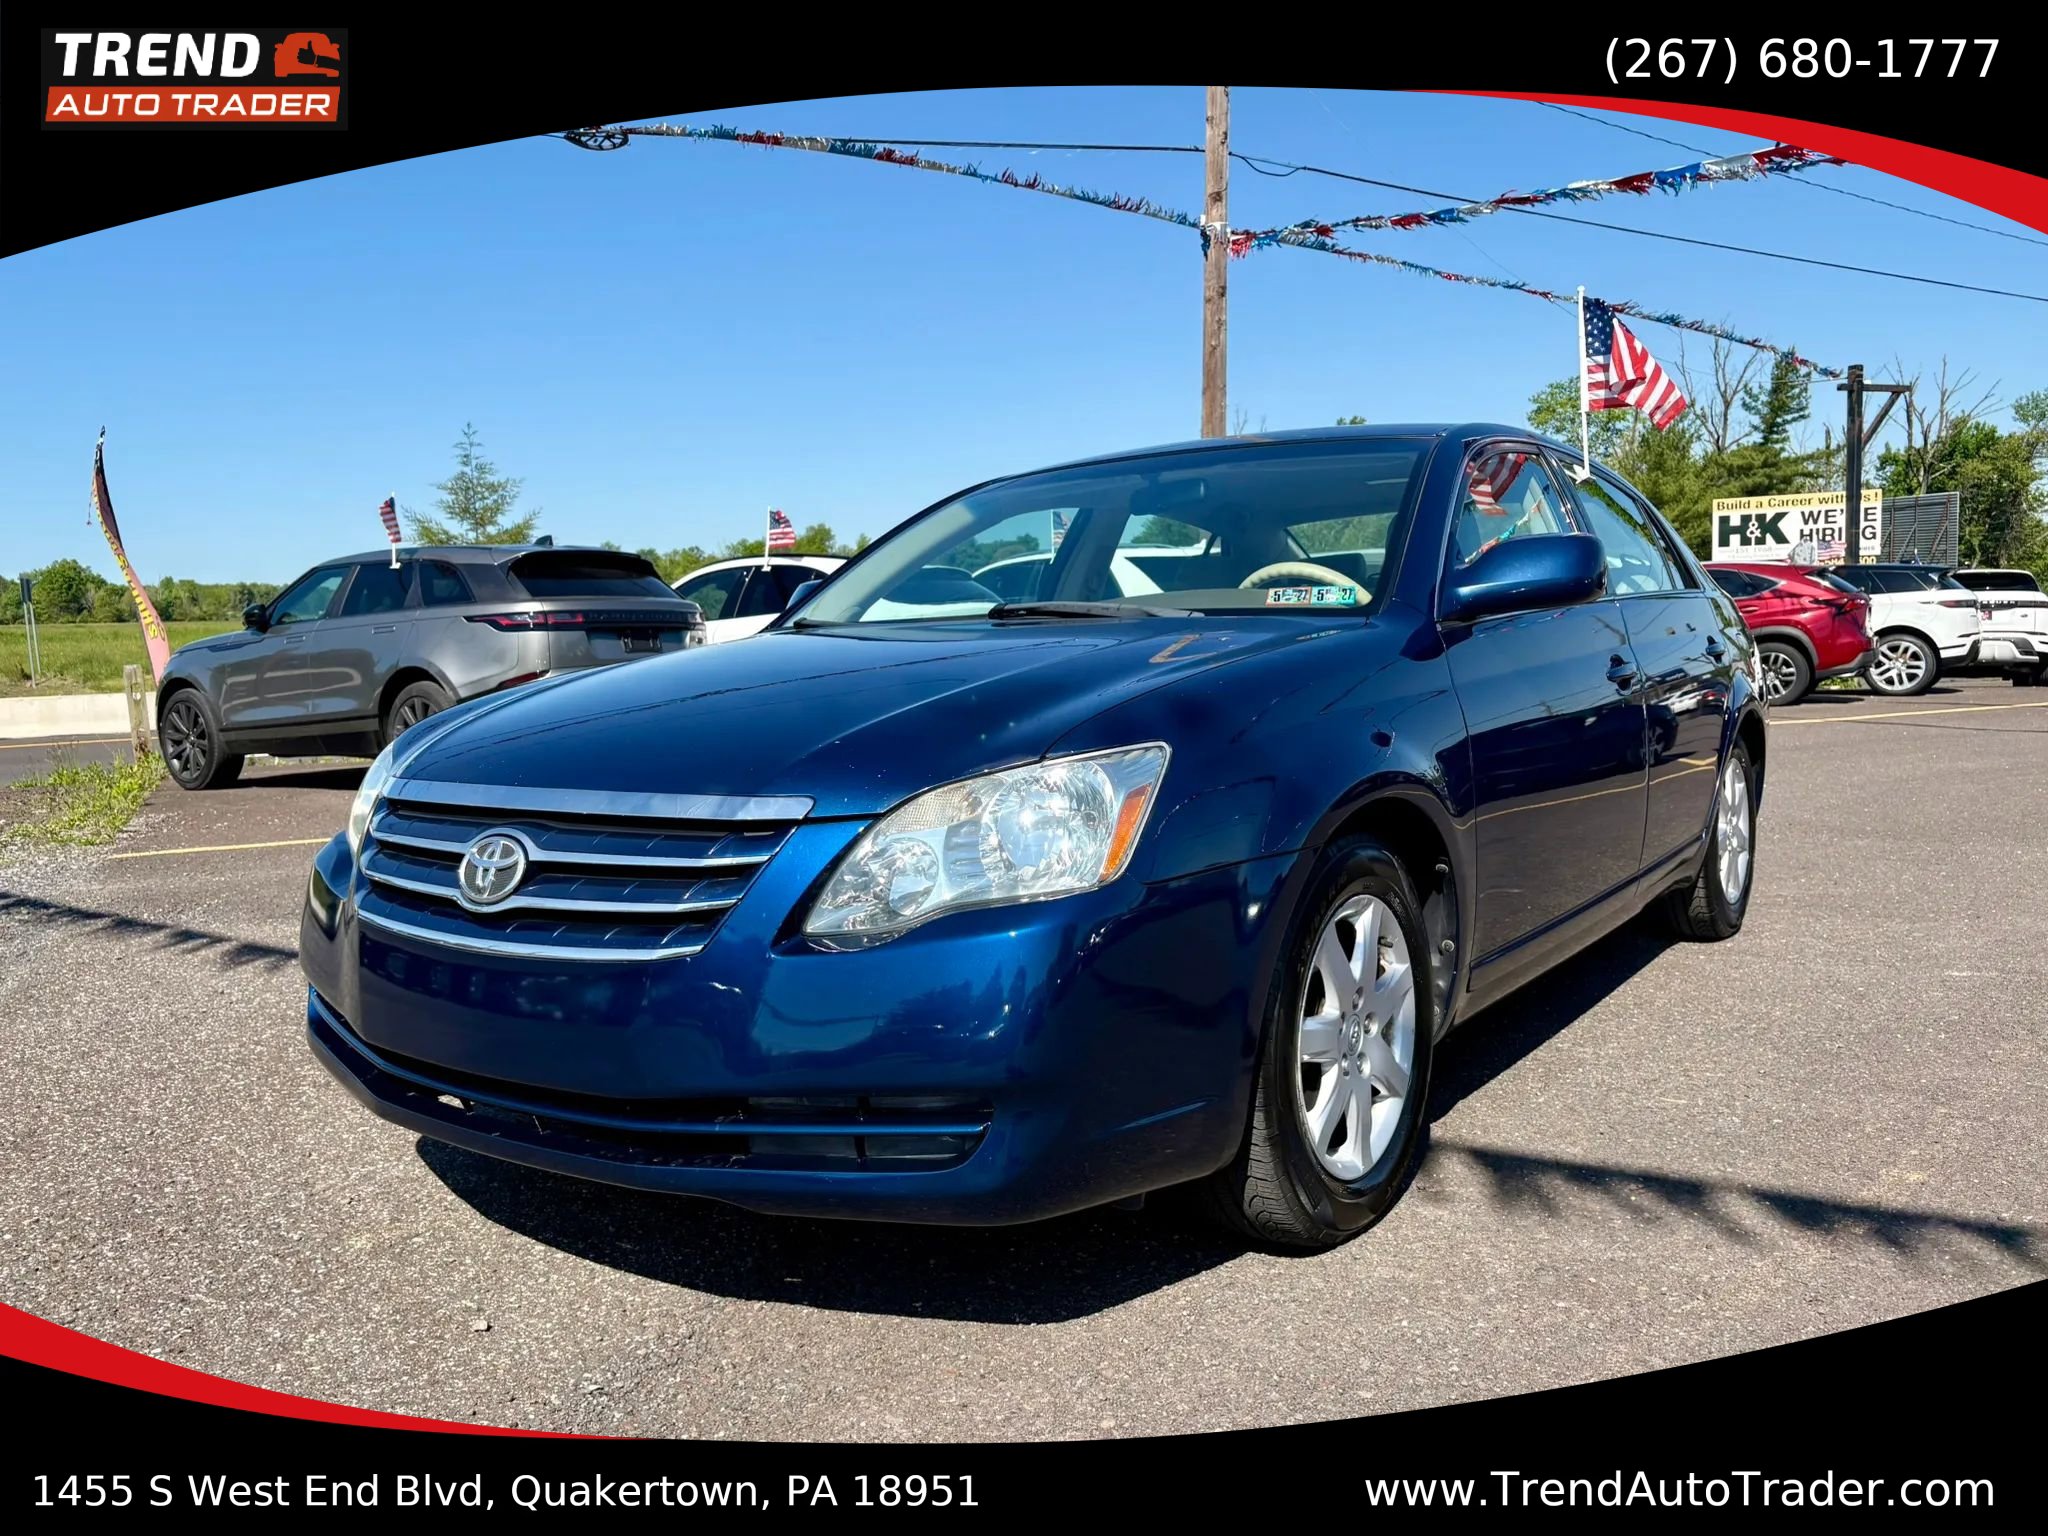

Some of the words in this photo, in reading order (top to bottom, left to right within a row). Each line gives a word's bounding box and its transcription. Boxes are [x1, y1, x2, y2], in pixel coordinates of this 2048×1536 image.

[1717, 500, 1751, 511] Build
[1755, 501, 1763, 509] a
[1768, 497, 1813, 508] Career
[1800, 507, 1878, 526] WE'E
[1718, 511, 1790, 547] H&K
[1799, 525, 1878, 543] HIRIG
